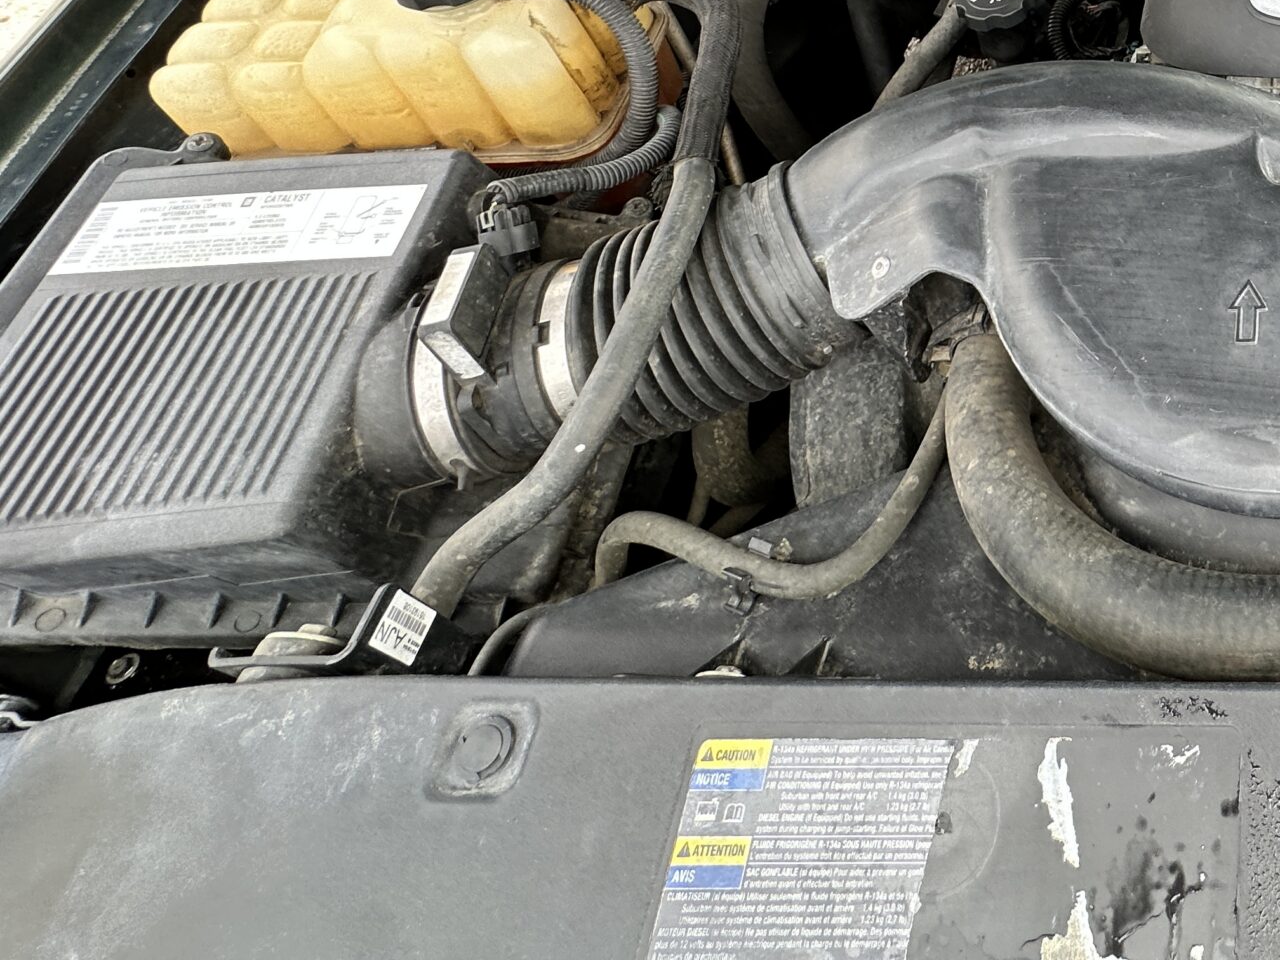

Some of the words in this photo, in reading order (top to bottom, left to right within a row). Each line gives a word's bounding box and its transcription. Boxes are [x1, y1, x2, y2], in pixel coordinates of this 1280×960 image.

[264, 192, 312, 204] CATALYST
[374, 620, 408, 650] AJN
[715, 748, 756, 762] CAUTION
[695, 773, 731, 785] NOTICE
[692, 844, 746, 857] ATTENTION
[671, 870, 696, 883] AVIS
